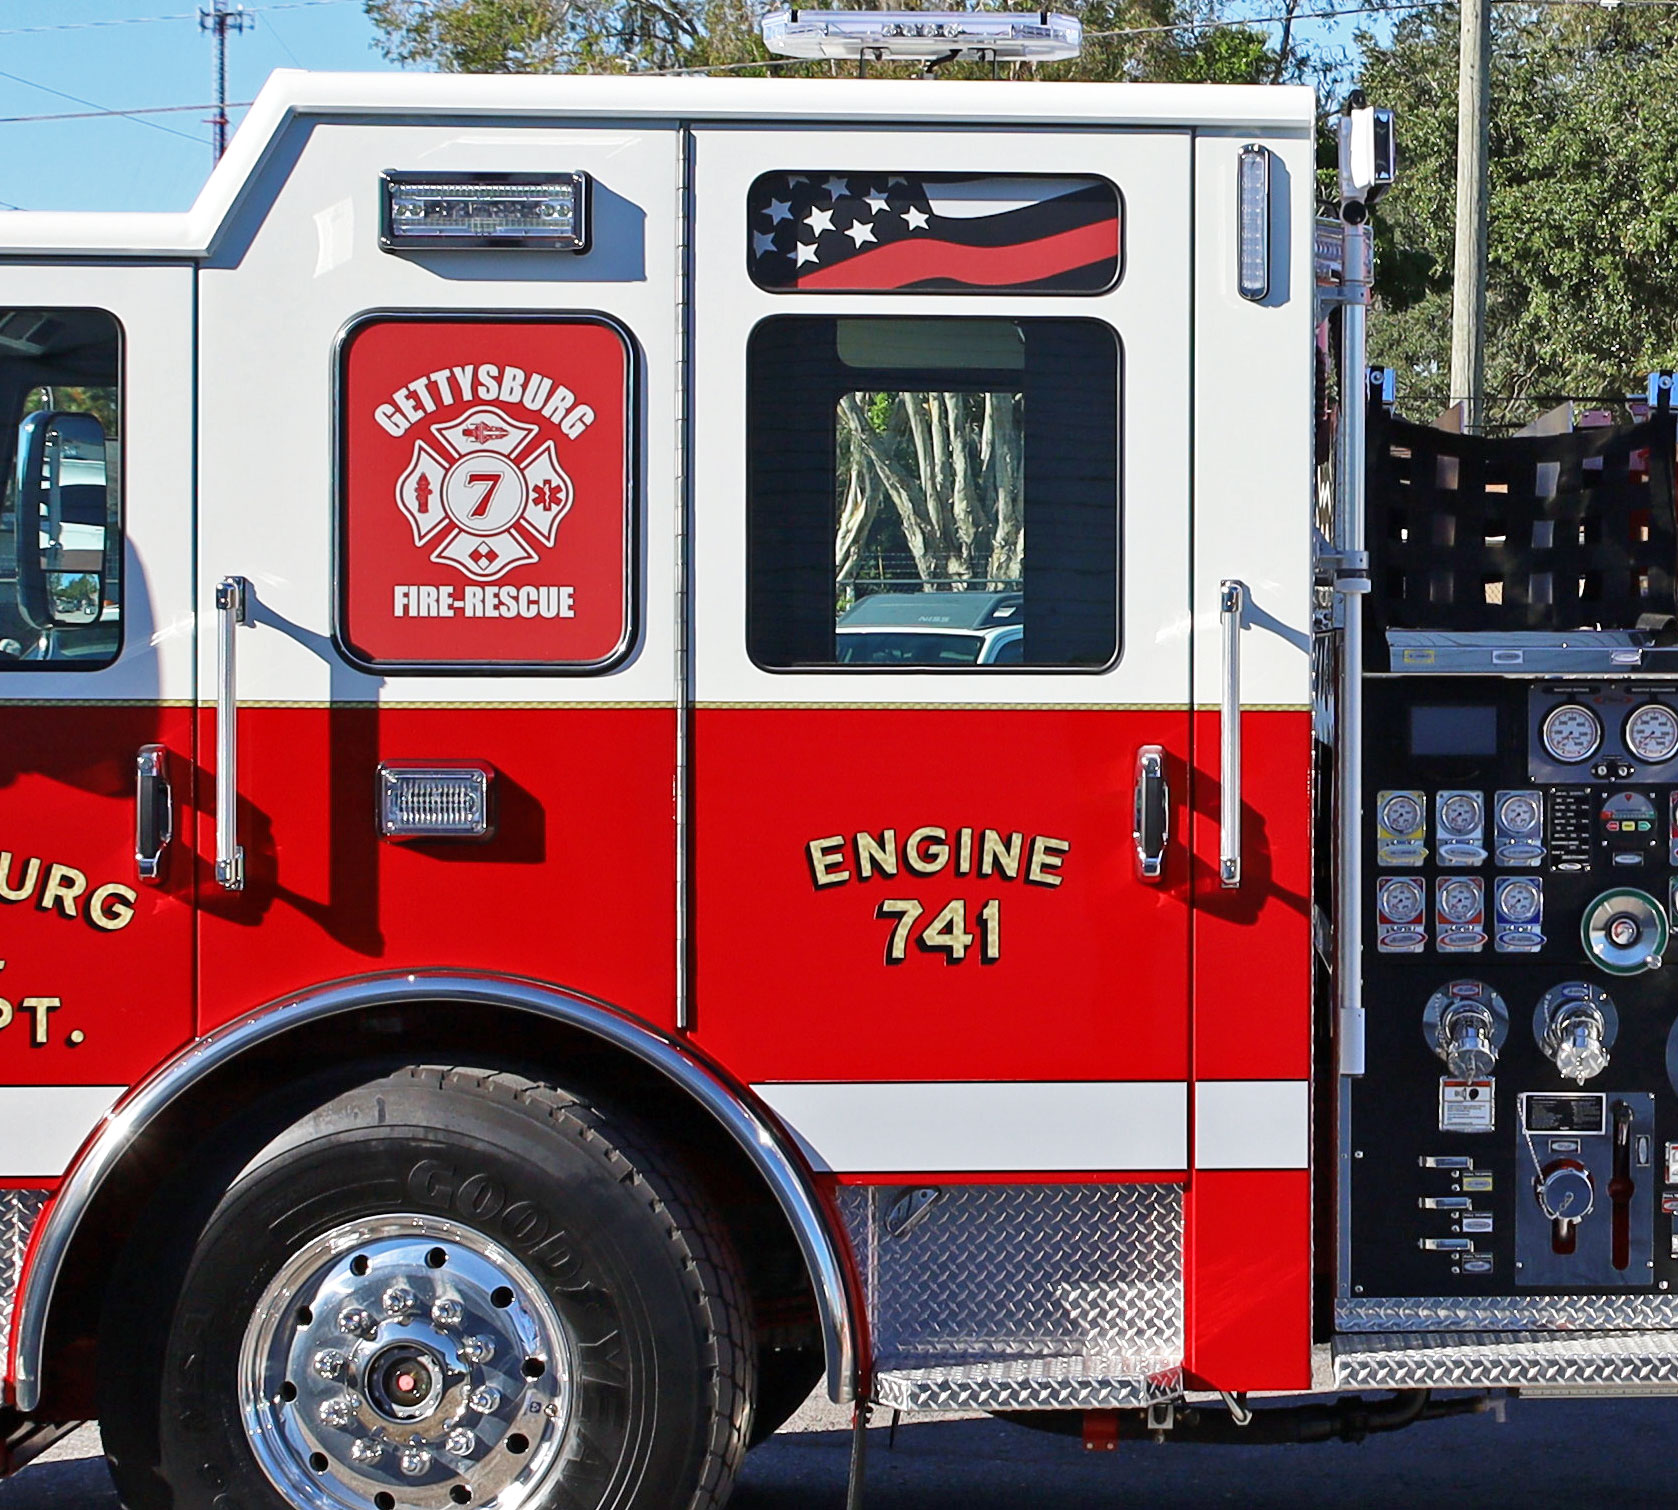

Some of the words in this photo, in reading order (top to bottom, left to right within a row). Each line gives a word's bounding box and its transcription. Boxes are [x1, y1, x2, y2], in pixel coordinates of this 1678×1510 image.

[373, 363, 597, 440] GETTYSBURG
[464, 471, 504, 520] 7
[393, 585, 576, 618] FIRE-RESCUE
[804, 826, 1070, 890] ENGINE
[874, 899, 1001, 966] 741
